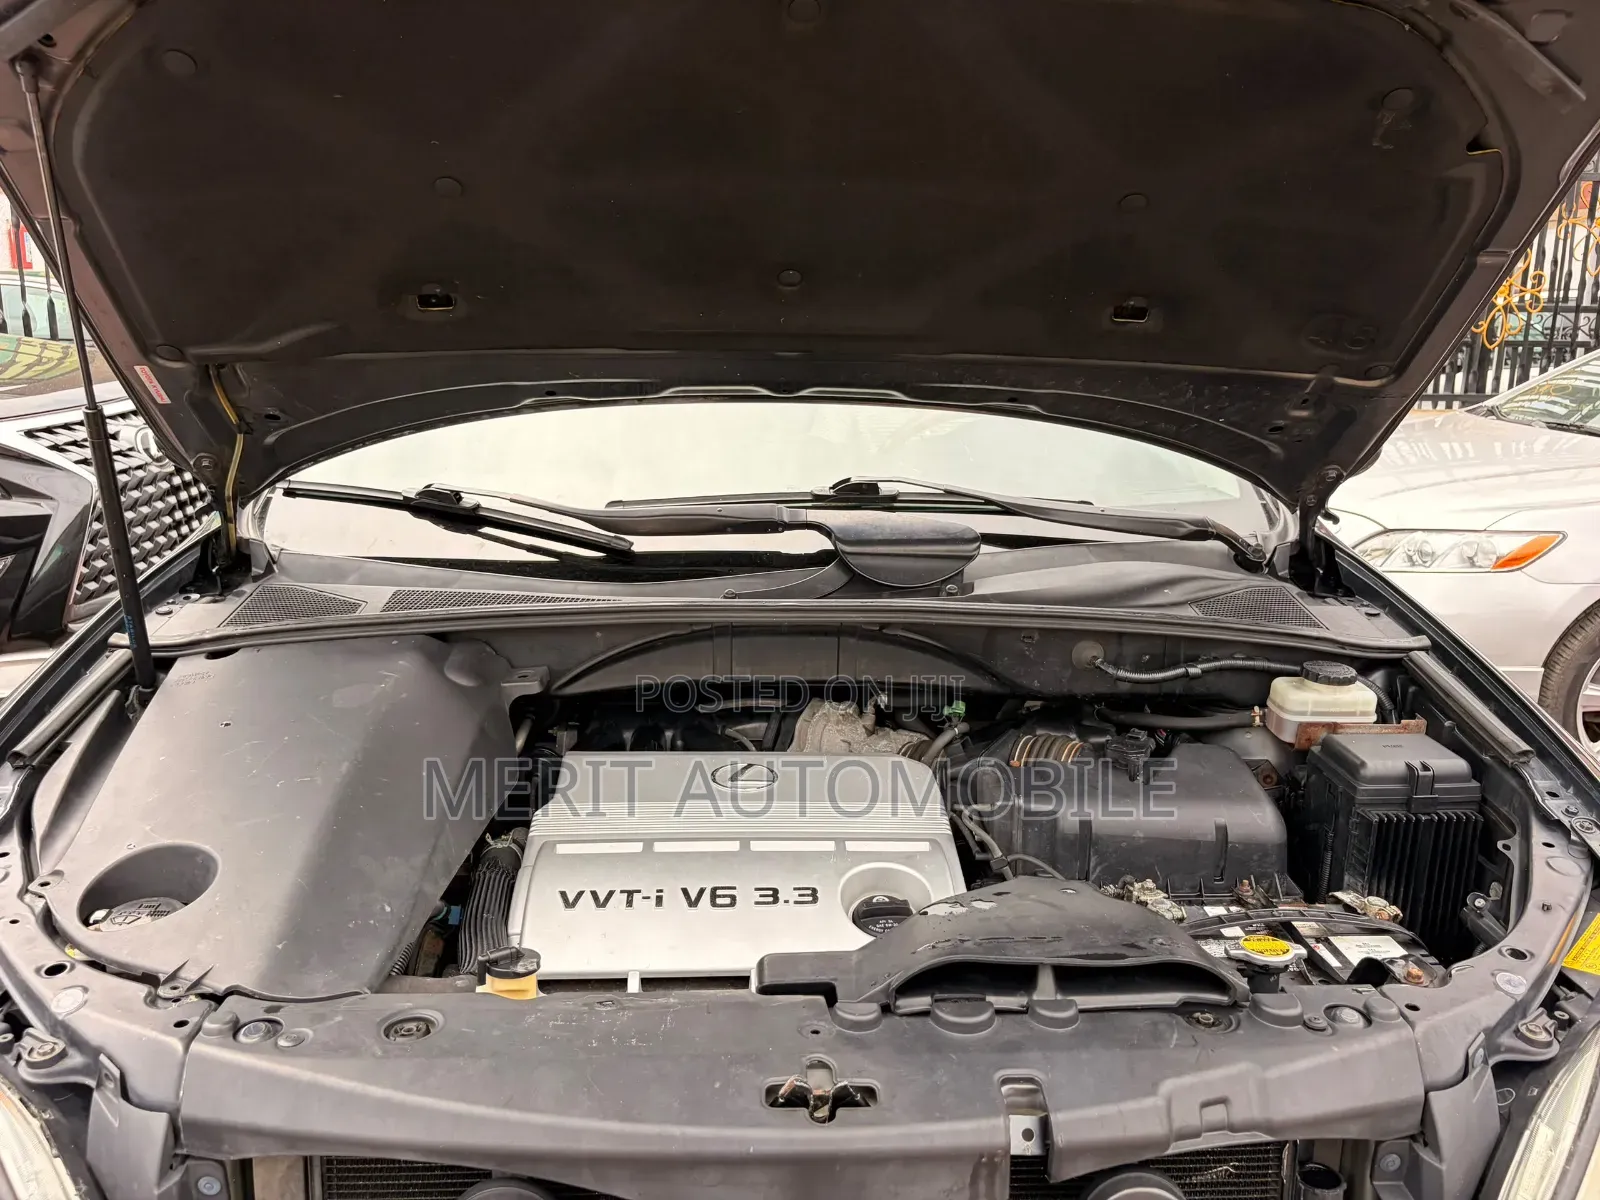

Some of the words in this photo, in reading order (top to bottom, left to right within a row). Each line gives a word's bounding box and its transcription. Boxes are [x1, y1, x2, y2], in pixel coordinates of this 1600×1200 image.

[558, 888, 665, 910] VVT-i
[680, 886, 738, 910] V6
[753, 886, 819, 907] 3.3
